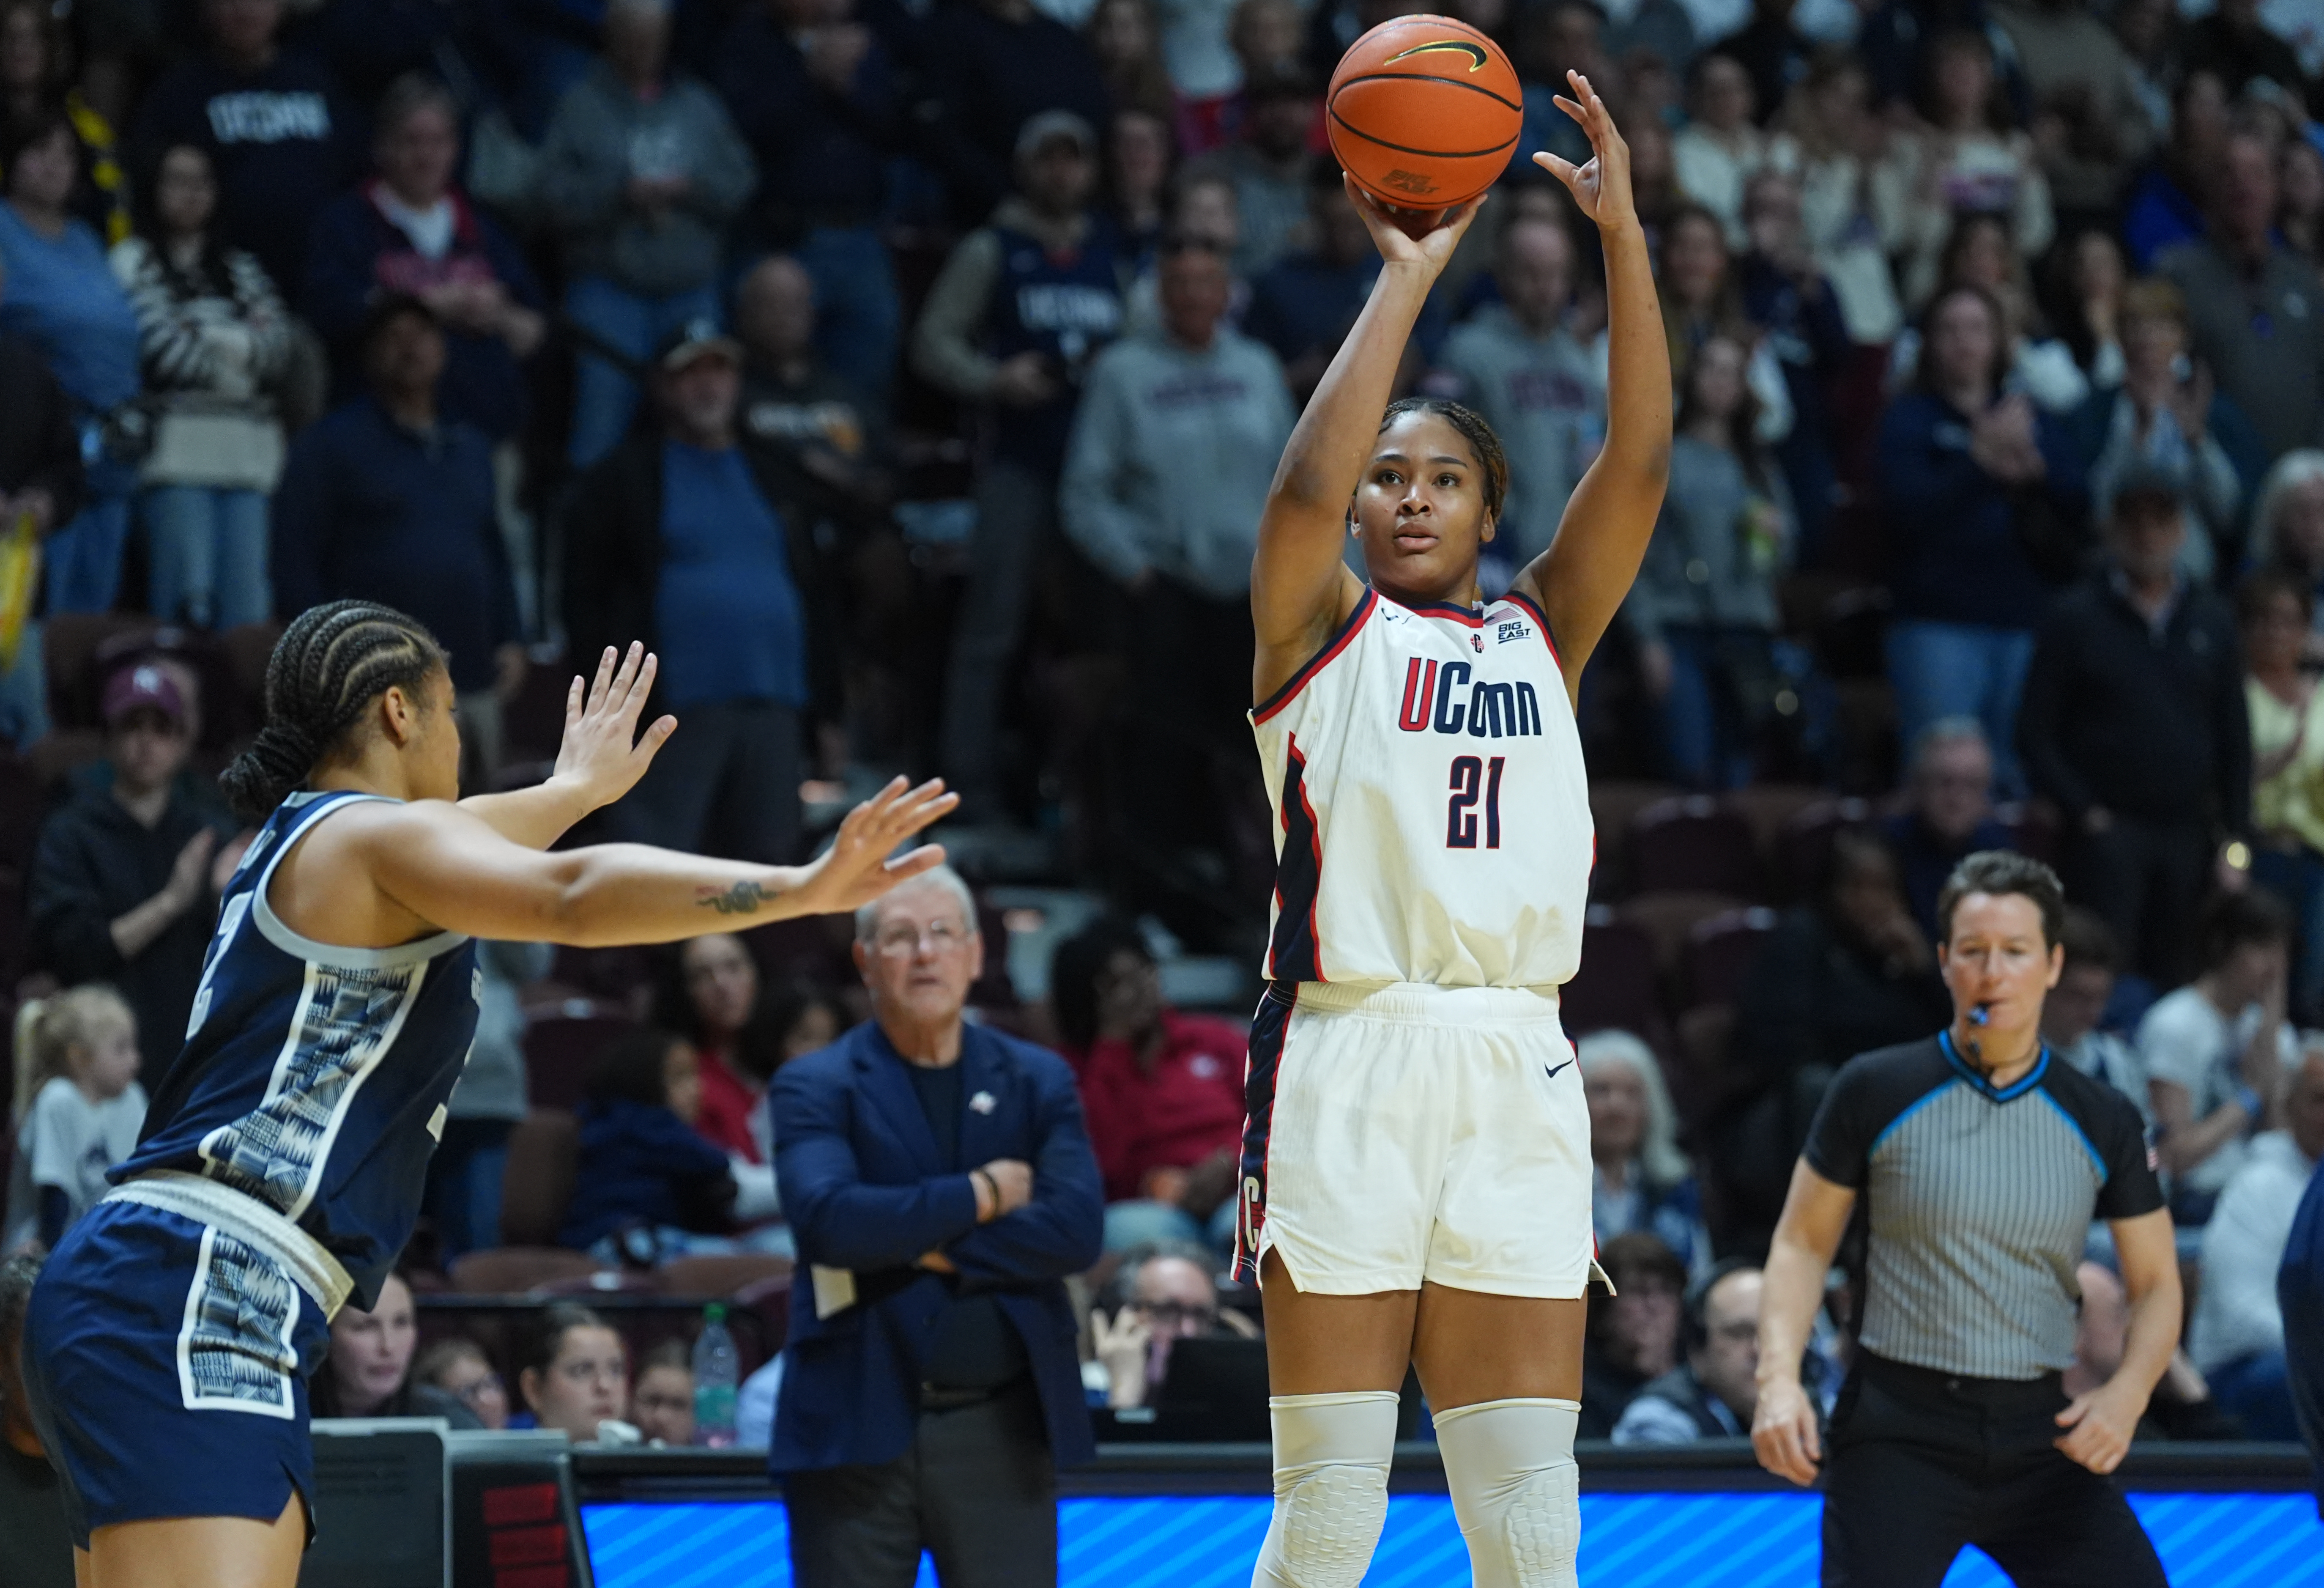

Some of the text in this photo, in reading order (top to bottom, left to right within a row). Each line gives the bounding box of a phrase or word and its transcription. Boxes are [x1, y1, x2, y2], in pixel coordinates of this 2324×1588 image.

[1498, 621, 1522, 632] BIG
[1498, 628, 1531, 640] EAST
[1446, 755, 1506, 849] 21
